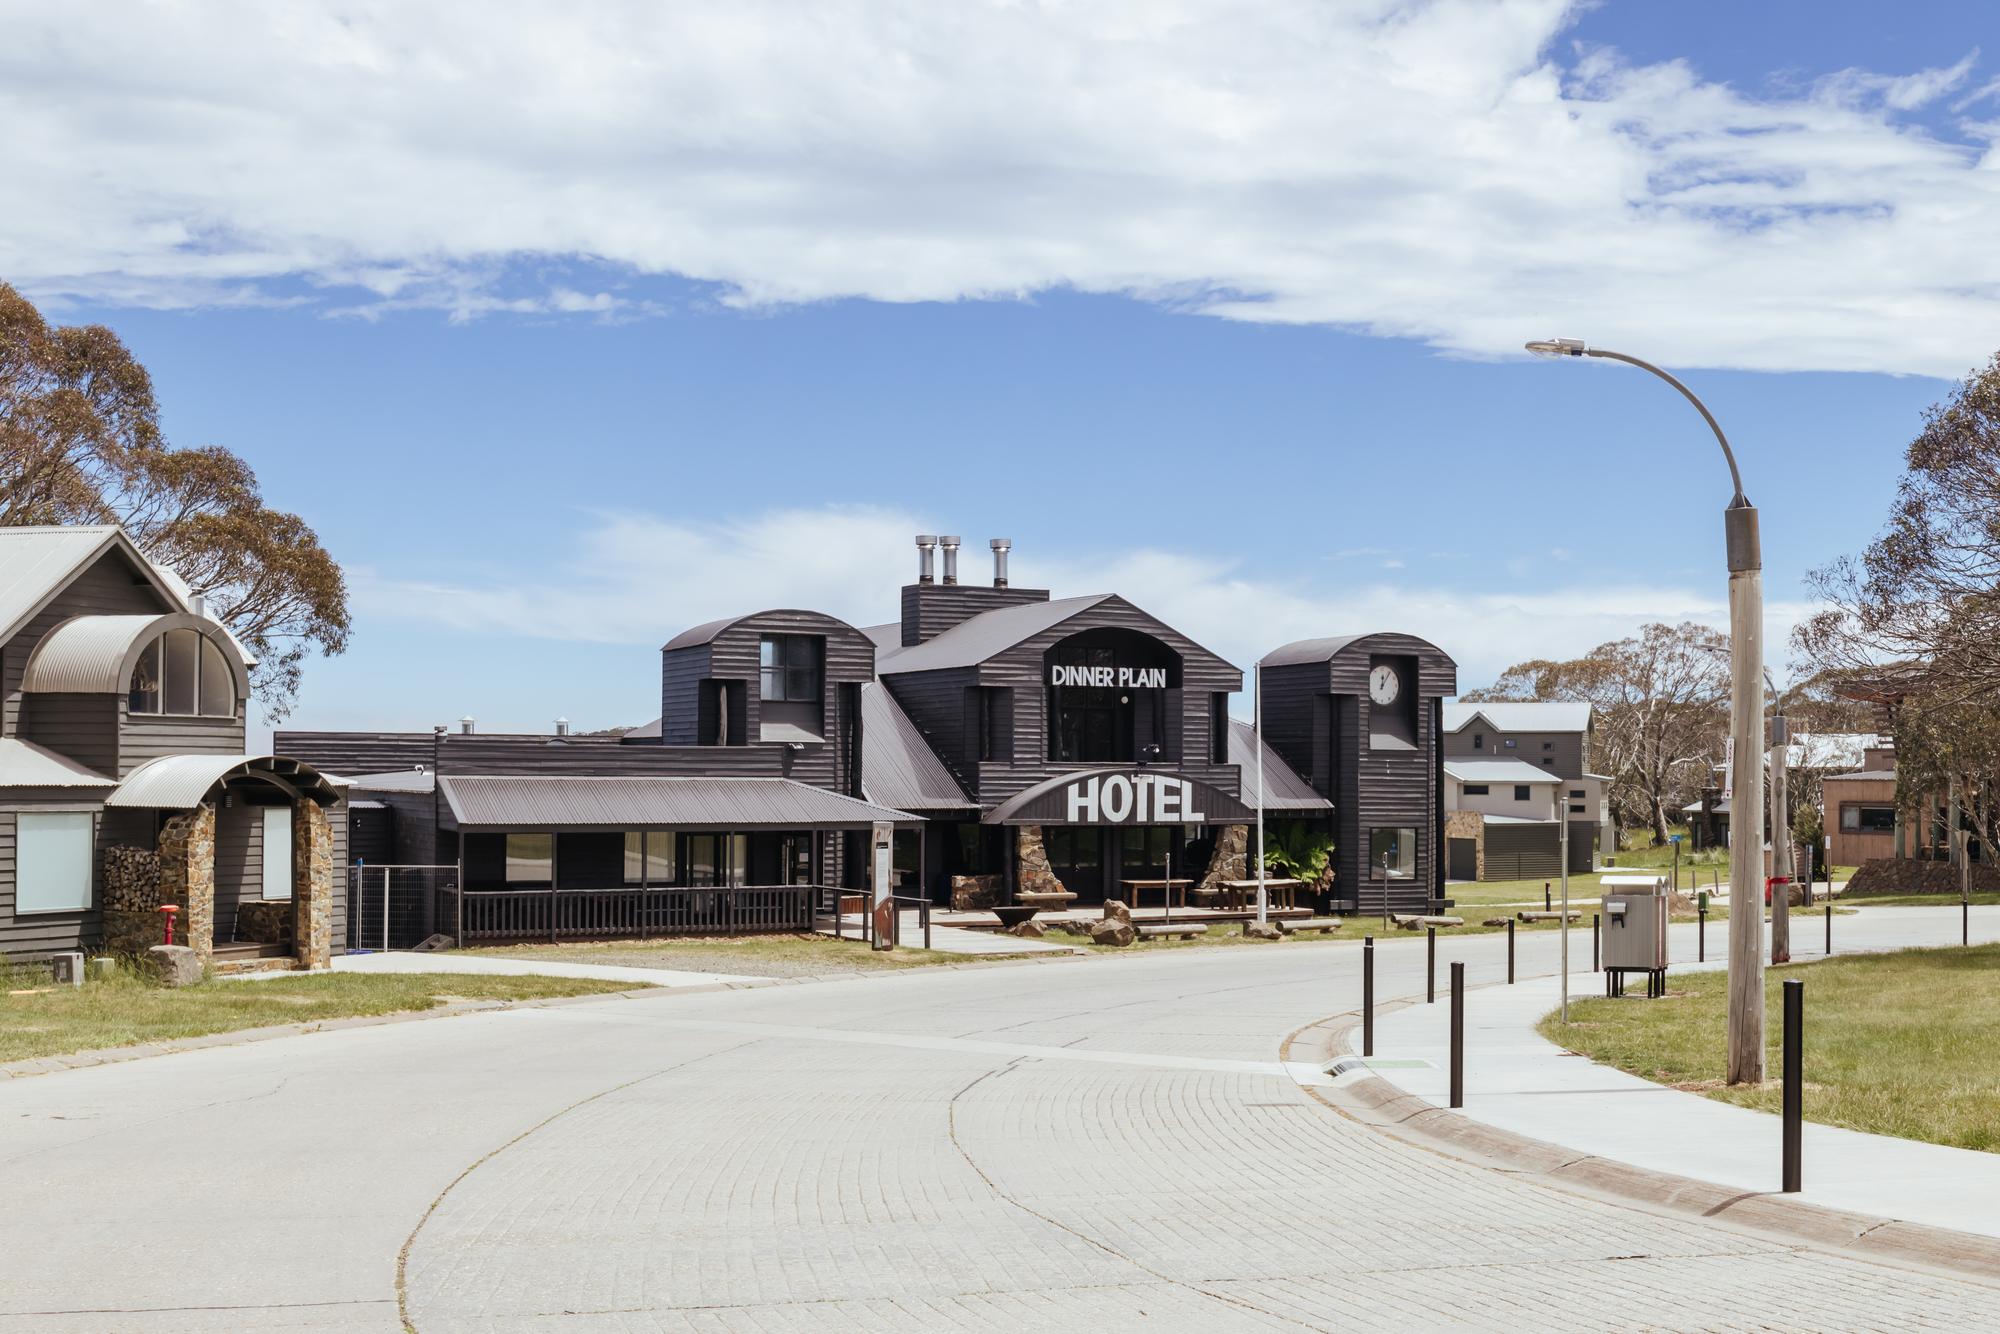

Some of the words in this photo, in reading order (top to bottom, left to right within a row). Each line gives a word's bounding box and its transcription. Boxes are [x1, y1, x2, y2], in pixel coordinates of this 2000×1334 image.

[1052, 665, 1114, 687] DINNER
[1118, 668, 1166, 688] PLAIN
[1067, 774, 1205, 822] HOTEL
